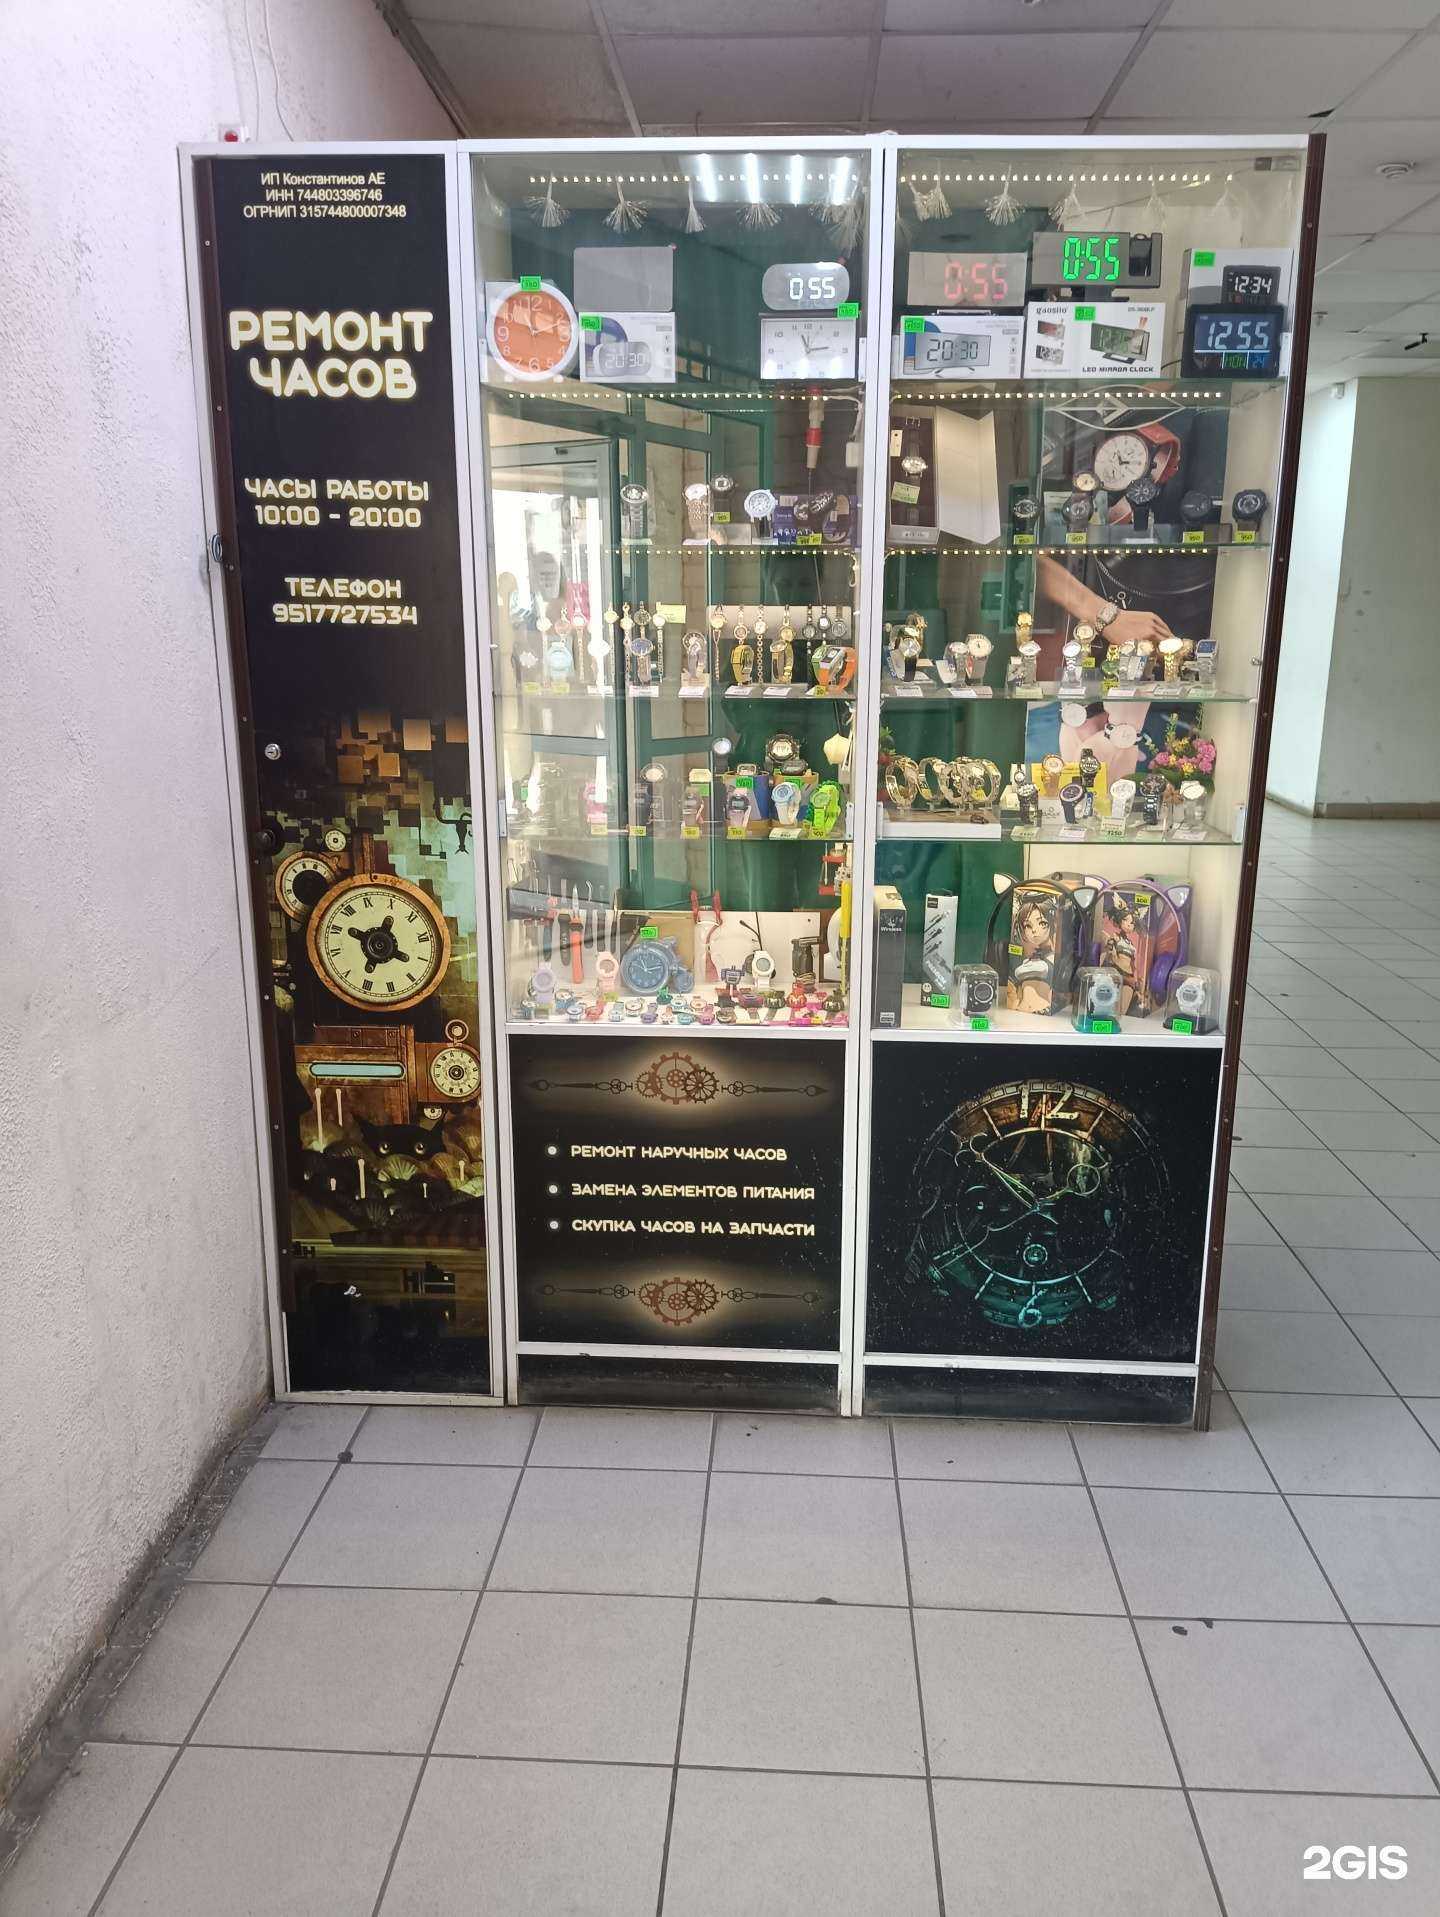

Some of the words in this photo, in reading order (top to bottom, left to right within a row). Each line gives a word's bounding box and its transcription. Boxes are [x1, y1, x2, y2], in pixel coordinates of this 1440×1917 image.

[260, 172, 280, 185] ИП
[283, 172, 366, 185] Константинов
[367, 172, 386, 185] АЕ
[265, 188, 294, 202] ИНН
[296, 188, 383, 202] 744803396746
[243, 204, 297, 218] ОГРНИП
[299, 204, 407, 218] 315744800007348
[228, 310, 434, 353] РЕМОНТ
[249, 356, 417, 399] ЧАСОВ
[244, 478, 317, 499] ЧАСЫ
[326, 479, 429, 502] РАБОТЫ
[255, 504, 321, 526] 10:00
[349, 506, 422, 528] 20:00
[284, 577, 402, 599] ТЕЛЕФОН
[272, 603, 418, 625] 9517727534
[571, 1145, 636, 1158] РЕМОНТ
[641, 1146, 729, 1160] НАРУЧНЫХ
[733, 1148, 788, 1161] ЧАСОВ
[571, 1183, 637, 1197] ЗАМЕНА
[641, 1184, 738, 1198] ЭЛЕМЕНТОВ
[742, 1187, 815, 1200] ПИТАНИЯ
[571, 1219, 636, 1232] СКУПКА
[640, 1220, 696, 1233] ЧАСОВ
[700, 1221, 724, 1234] НА
[728, 1222, 815, 1236] ЗАПЧАСТИ
